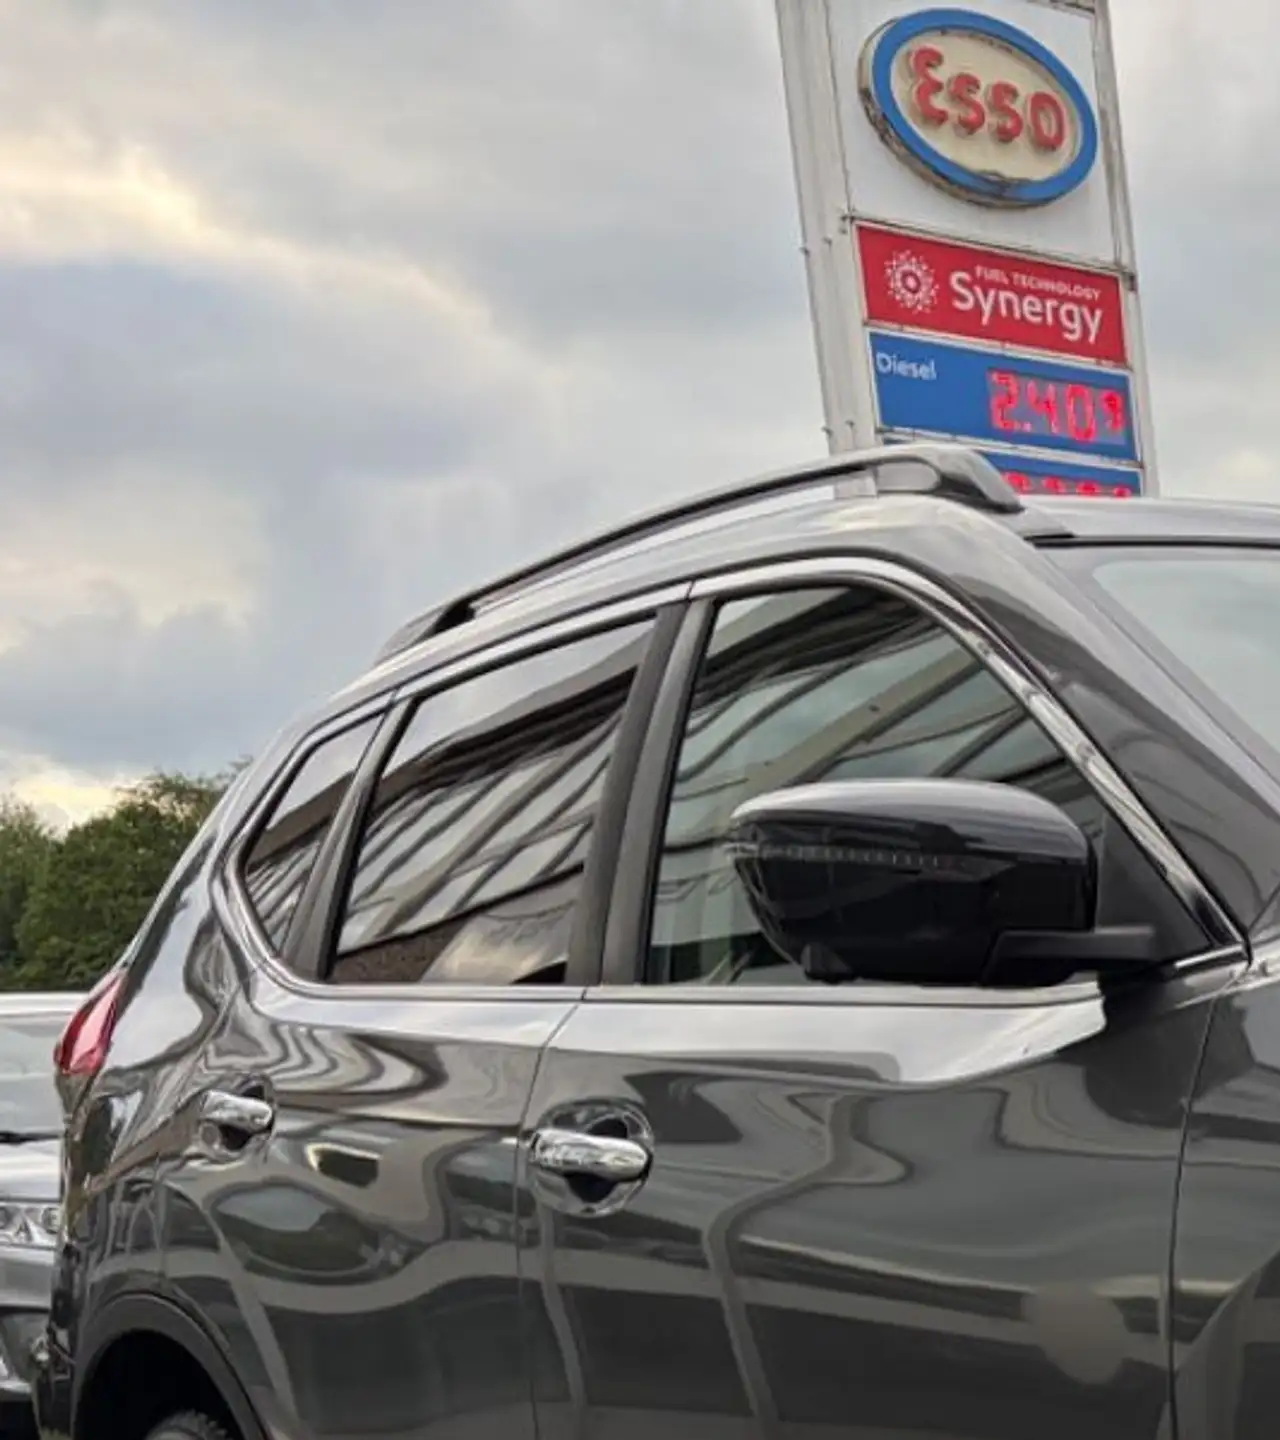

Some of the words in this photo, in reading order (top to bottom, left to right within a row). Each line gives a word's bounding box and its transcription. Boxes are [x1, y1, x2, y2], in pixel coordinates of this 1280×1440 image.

[975, 264, 1008, 285] FUEL
[1012, 272, 1101, 301] TECHNOLOGY
[949, 271, 1103, 345] Synergy
[876, 352, 937, 381] Diesel
